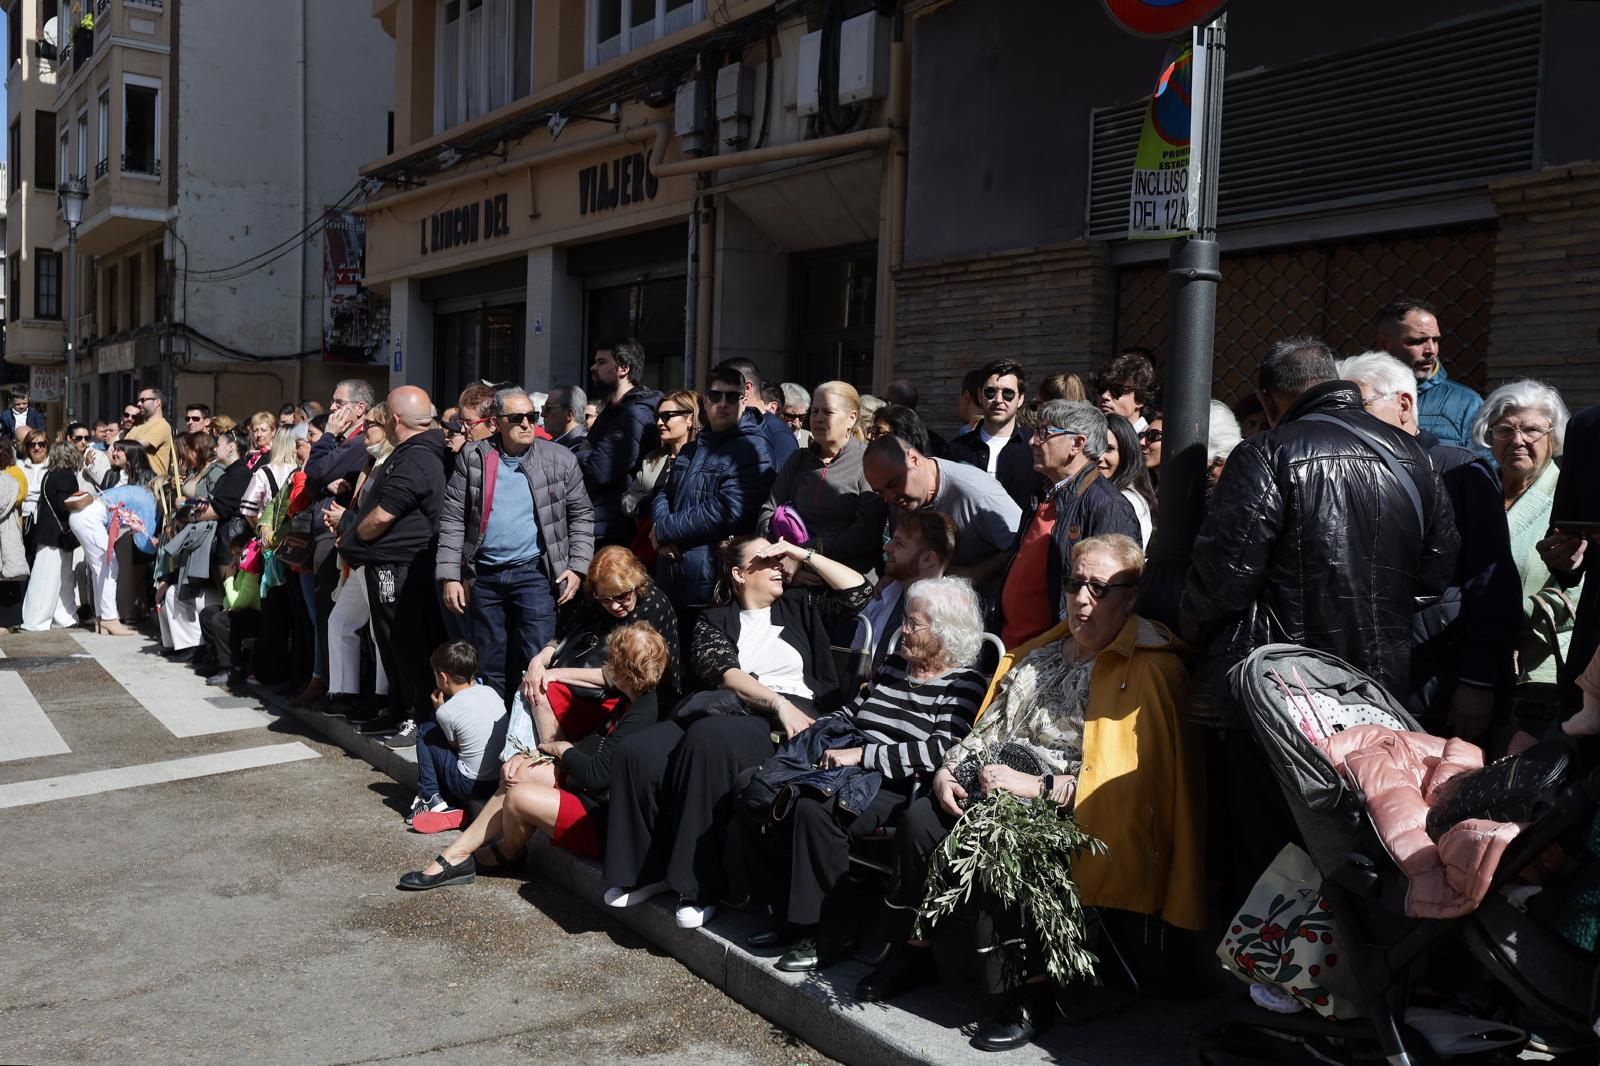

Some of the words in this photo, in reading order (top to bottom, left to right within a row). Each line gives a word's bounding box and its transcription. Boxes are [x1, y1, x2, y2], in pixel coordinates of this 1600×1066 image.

[1135, 169, 1188, 195] INCLUSO
[431, 202, 480, 252] RINCON
[484, 193, 510, 240] DEL
[1134, 201, 1160, 231] DEL
